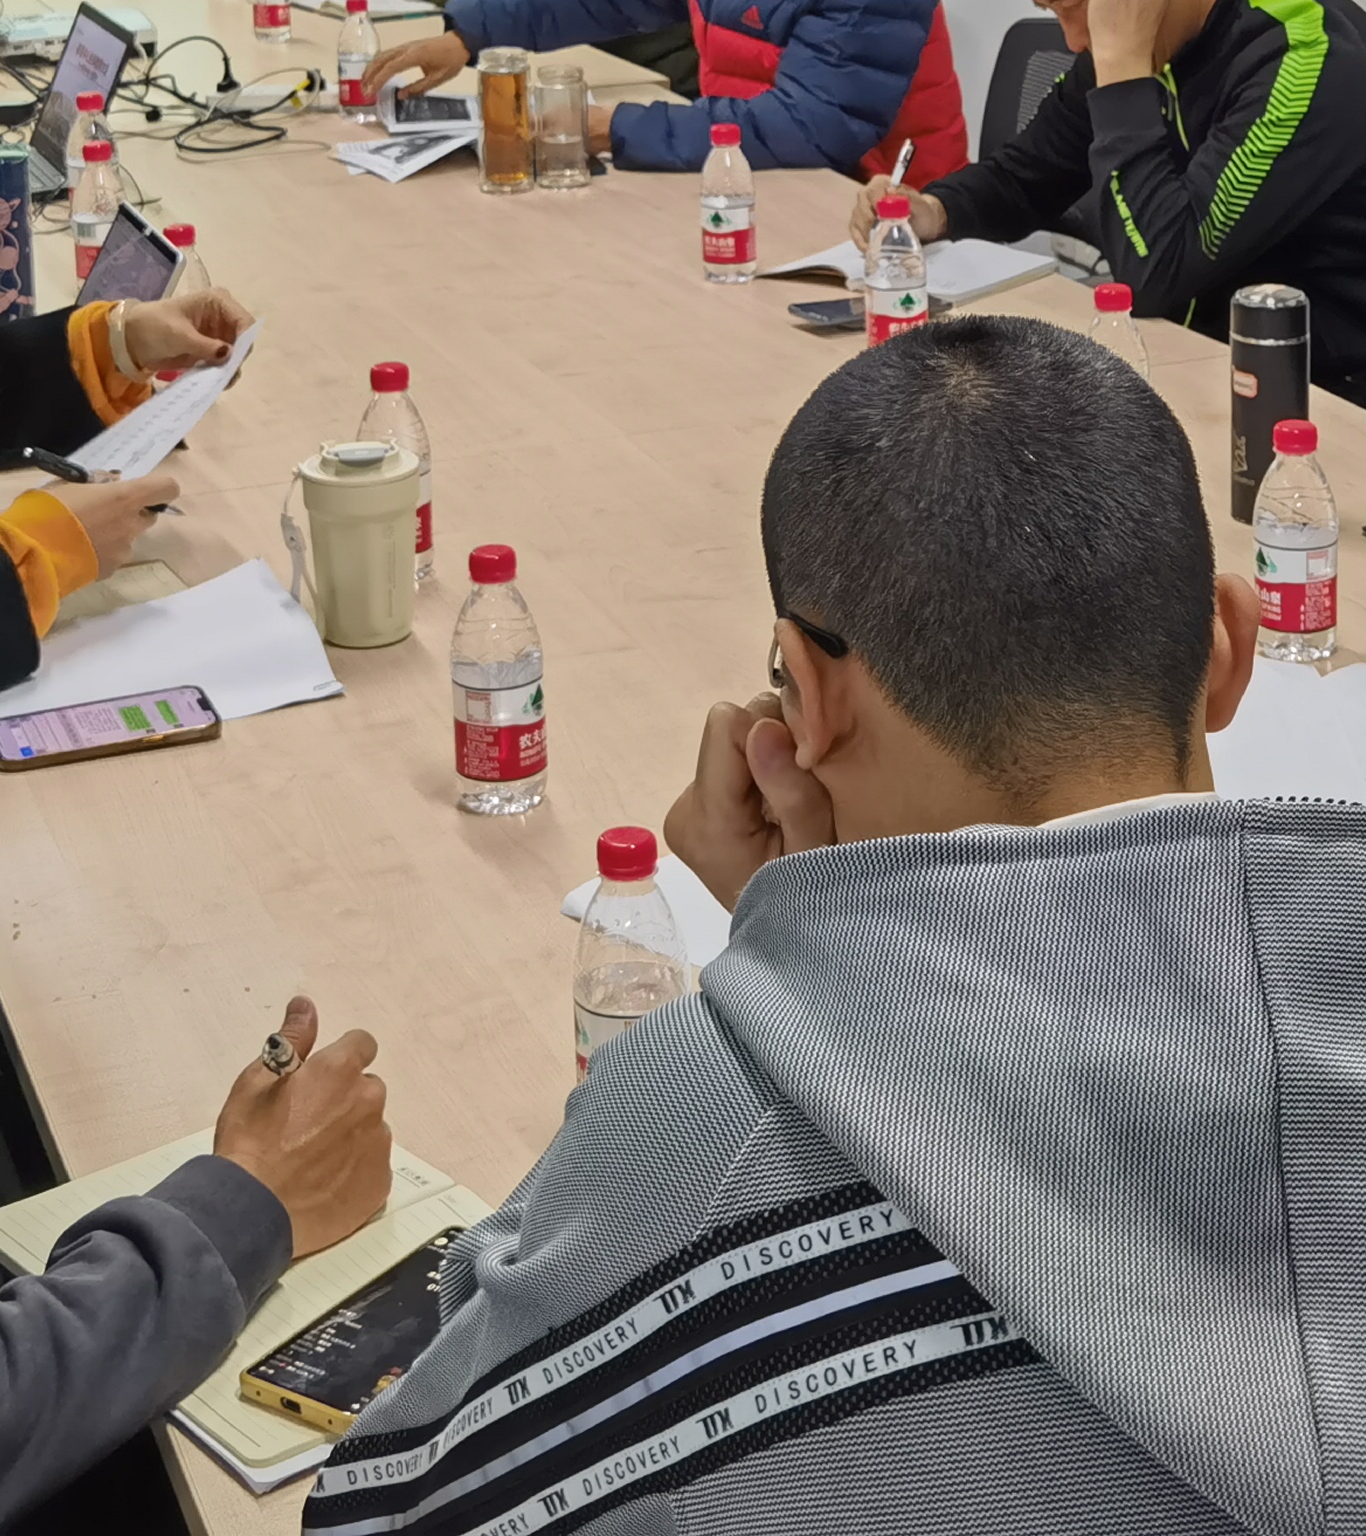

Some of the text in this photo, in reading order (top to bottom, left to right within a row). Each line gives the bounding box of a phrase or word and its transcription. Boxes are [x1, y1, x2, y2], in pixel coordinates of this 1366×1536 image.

[542, 1317, 638, 1384] DISCOVERY
[721, 1209, 896, 1280] DISCOVERY
[582, 1436, 681, 1496] DISCOVERY
[755, 1339, 917, 1413] DISCOVERY
